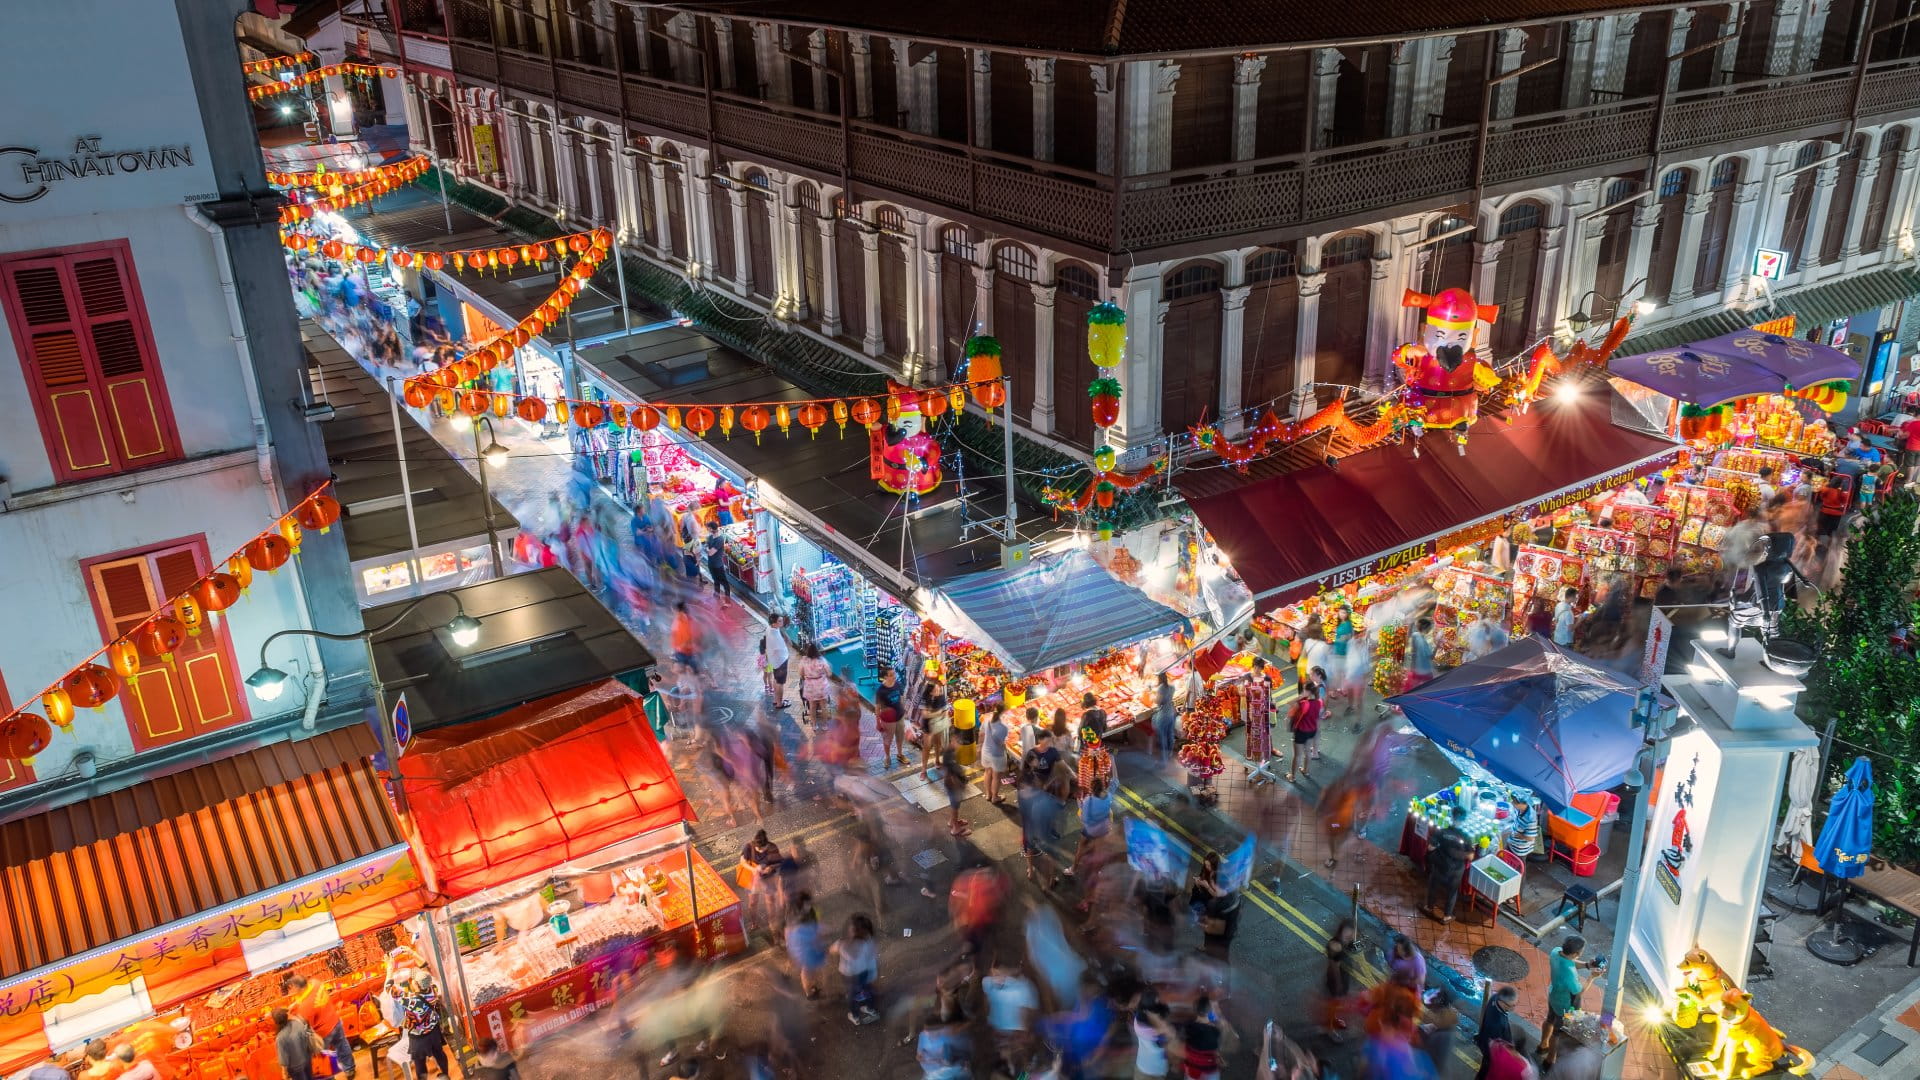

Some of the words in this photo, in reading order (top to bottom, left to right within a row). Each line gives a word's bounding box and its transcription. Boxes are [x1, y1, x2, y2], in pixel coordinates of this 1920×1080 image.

[75, 136, 102, 153] AT
[0, 144, 194, 203] CHINATOWN
[1539, 486, 1591, 513] Wholesale
[1594, 479, 1602, 493] &
[1606, 467, 1635, 490] Retail
[1332, 562, 1373, 588] LESLIE
